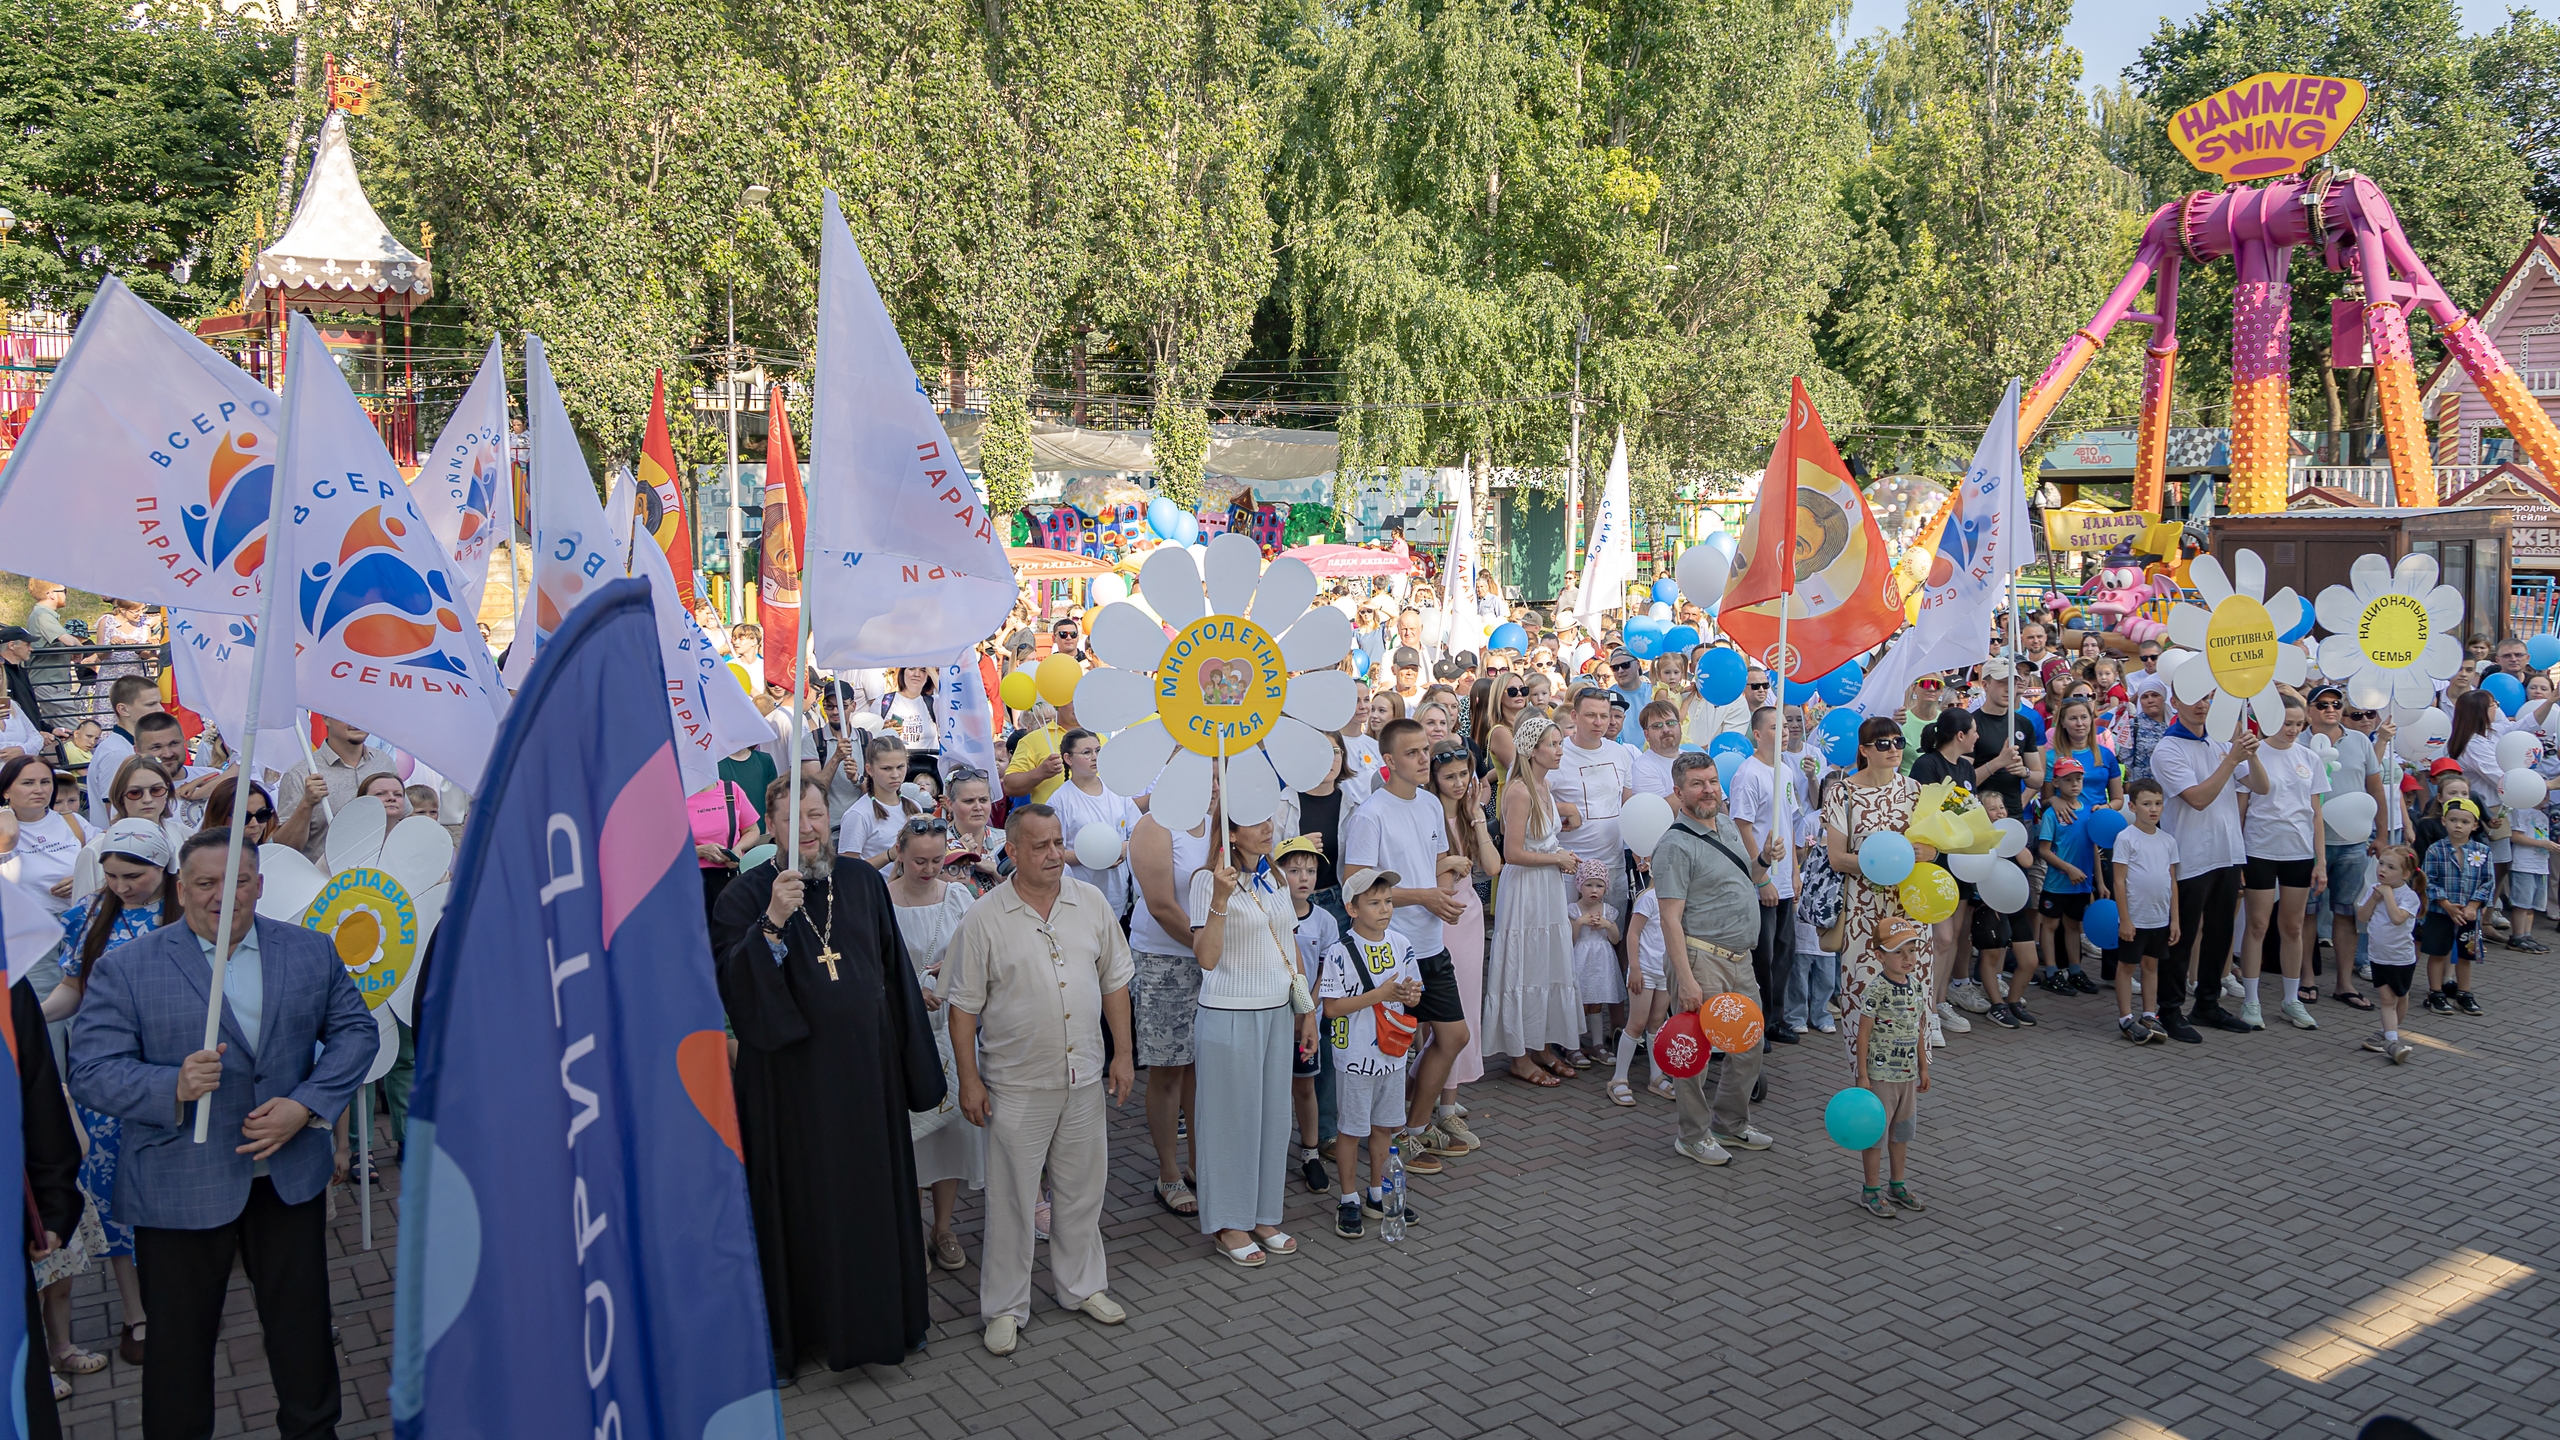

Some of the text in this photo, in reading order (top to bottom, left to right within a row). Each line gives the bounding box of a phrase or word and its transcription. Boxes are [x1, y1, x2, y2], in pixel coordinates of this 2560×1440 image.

[2178, 78, 2347, 143] HAMMER
[2196, 117, 2327, 163] SWING
[2073, 446, 2098, 457] АВТО
[2080, 455, 2112, 464] РАДИО
[916, 441, 992, 544] ПАРАД
[136, 497, 202, 587] ПАРАД
[2082, 514, 2147, 530] HAMMER
[2359, 596, 2427, 640] НАЦИОНАЛЬНАЯ
[1161, 622, 1281, 698] МНОГОДЕТНАЯ
[2209, 631, 2275, 649] СПОРТИВНАЯ
[2230, 649, 2264, 663] СЕМЬЯ
[2371, 650, 2412, 662] СЕМЬЯ
[330, 661, 469, 699] СЕМЬИ
[667, 679, 713, 751] ПАРАД
